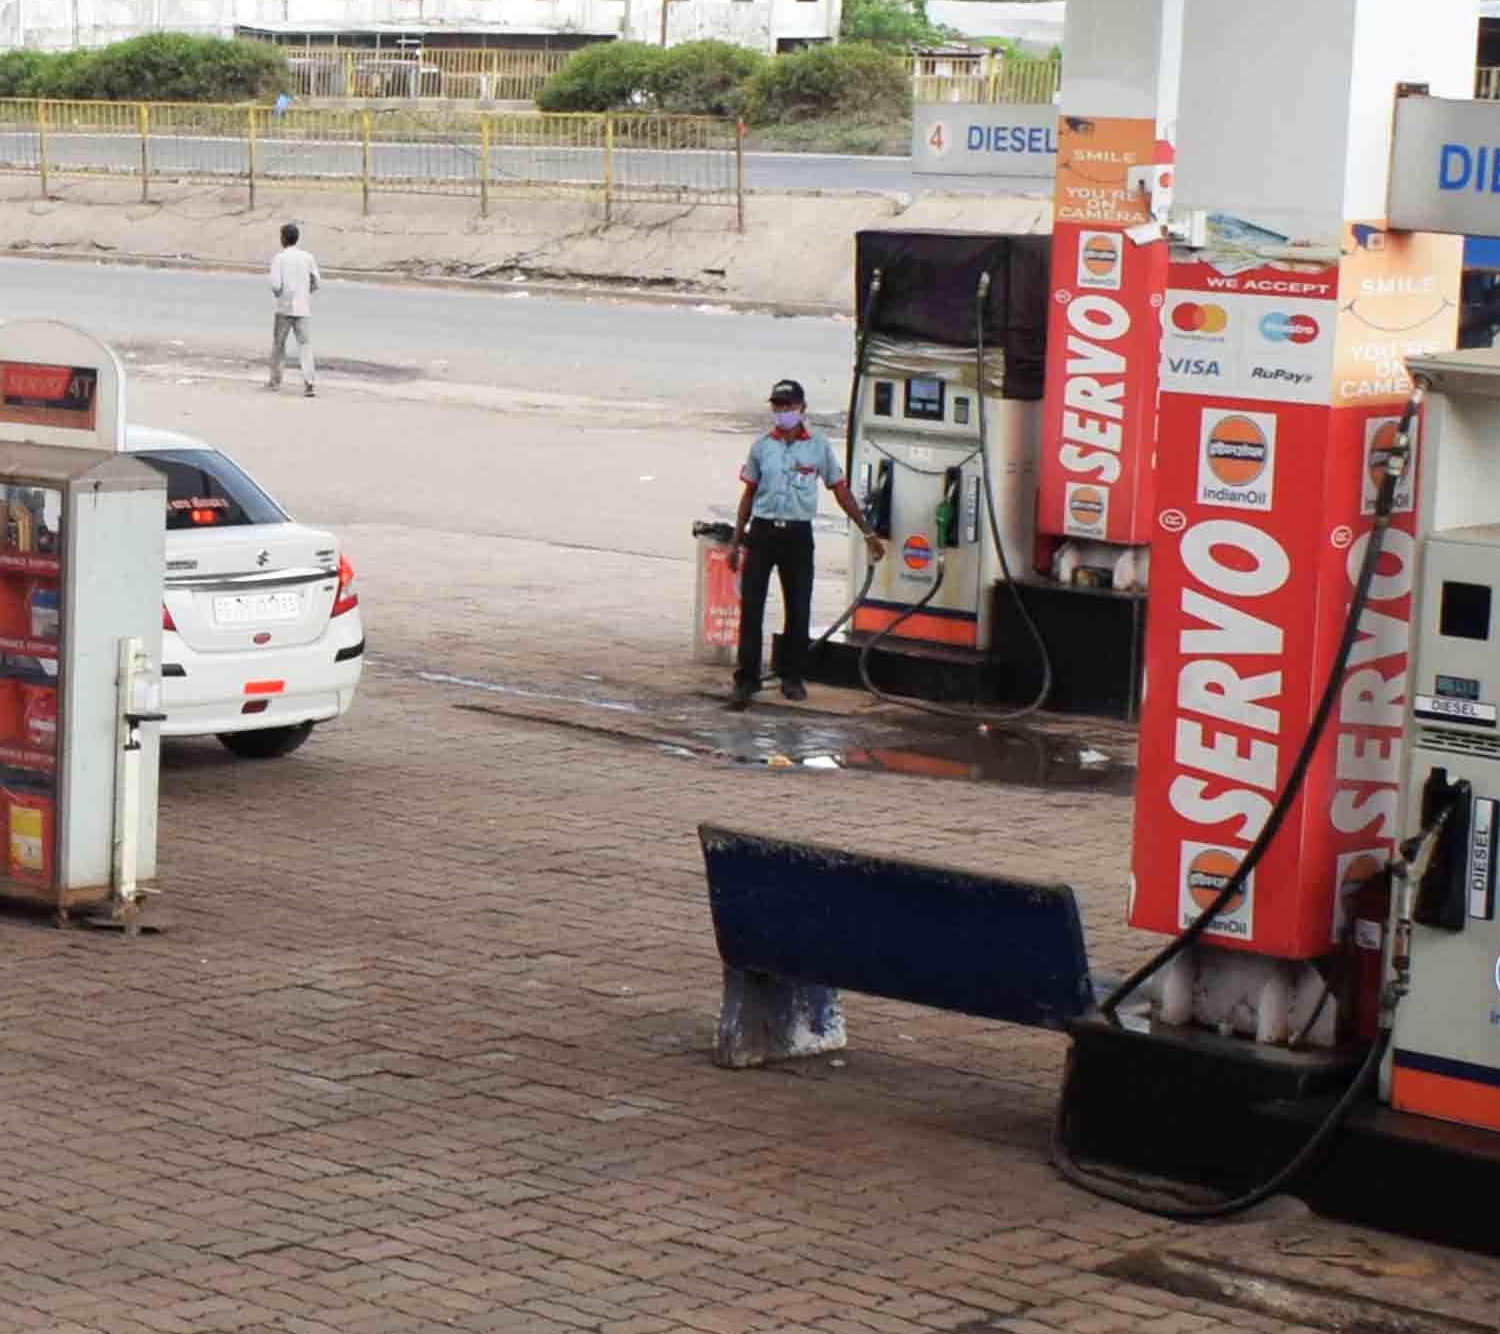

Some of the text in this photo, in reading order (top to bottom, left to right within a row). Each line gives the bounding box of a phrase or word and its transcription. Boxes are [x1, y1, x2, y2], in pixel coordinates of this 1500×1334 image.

[928, 125, 1058, 155] 4 DIESEL
[1072, 149, 1136, 164] SMILE
[1060, 206, 1145, 221] CAMERA
[1206, 276, 1331, 295] WE ACCEPT
[1167, 358, 1221, 377] VISA
[1251, 366, 1303, 384] RuPay
[1059, 294, 1131, 483] SERVO
[1340, 378, 1415, 397] CAME
[1202, 487, 1267, 506] IndianOil
[1169, 518, 1291, 845] SERVO
[1431, 698, 1478, 717] DIESEL
[1473, 828, 1488, 892] DIESEL
